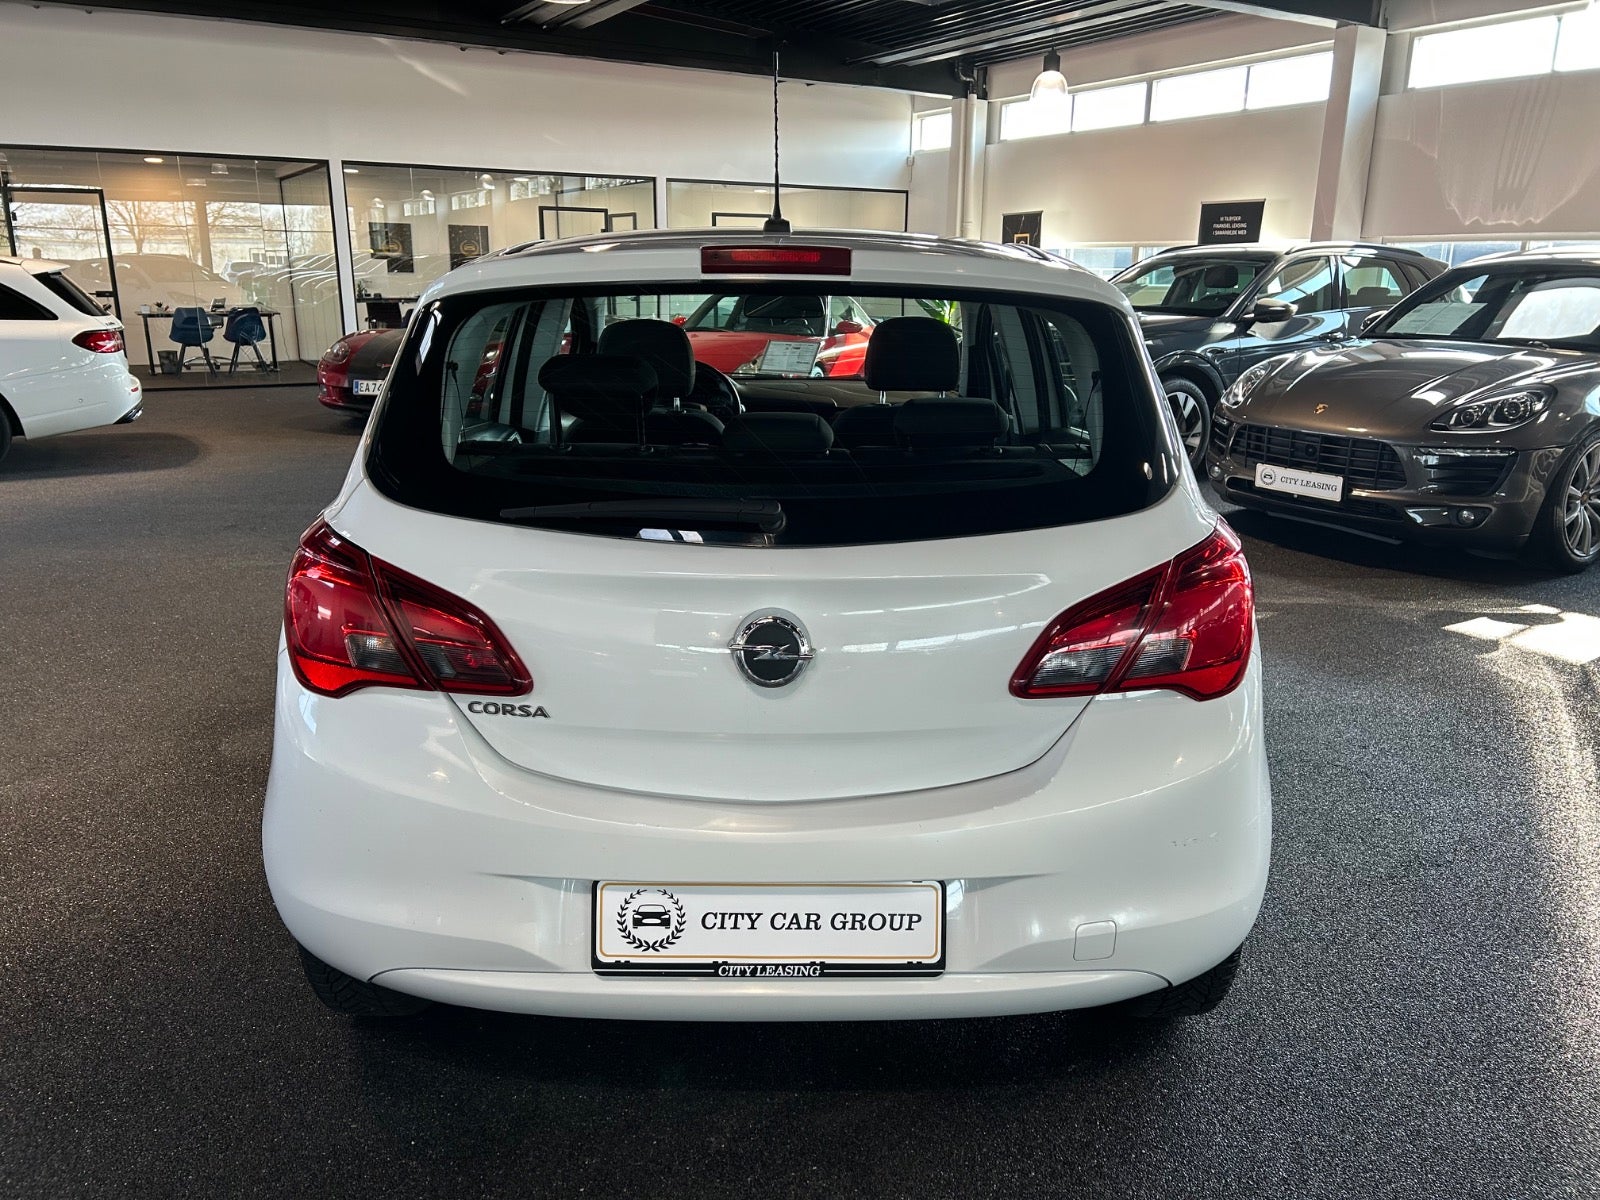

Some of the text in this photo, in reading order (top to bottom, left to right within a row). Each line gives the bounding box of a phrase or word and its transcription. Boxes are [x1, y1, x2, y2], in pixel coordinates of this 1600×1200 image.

[1280, 476, 1338, 492] CITY LEASING
[467, 700, 551, 719] CORSA
[700, 911, 923, 932] CITY CAR GROUP
[718, 965, 821, 977] CITY LEASING
